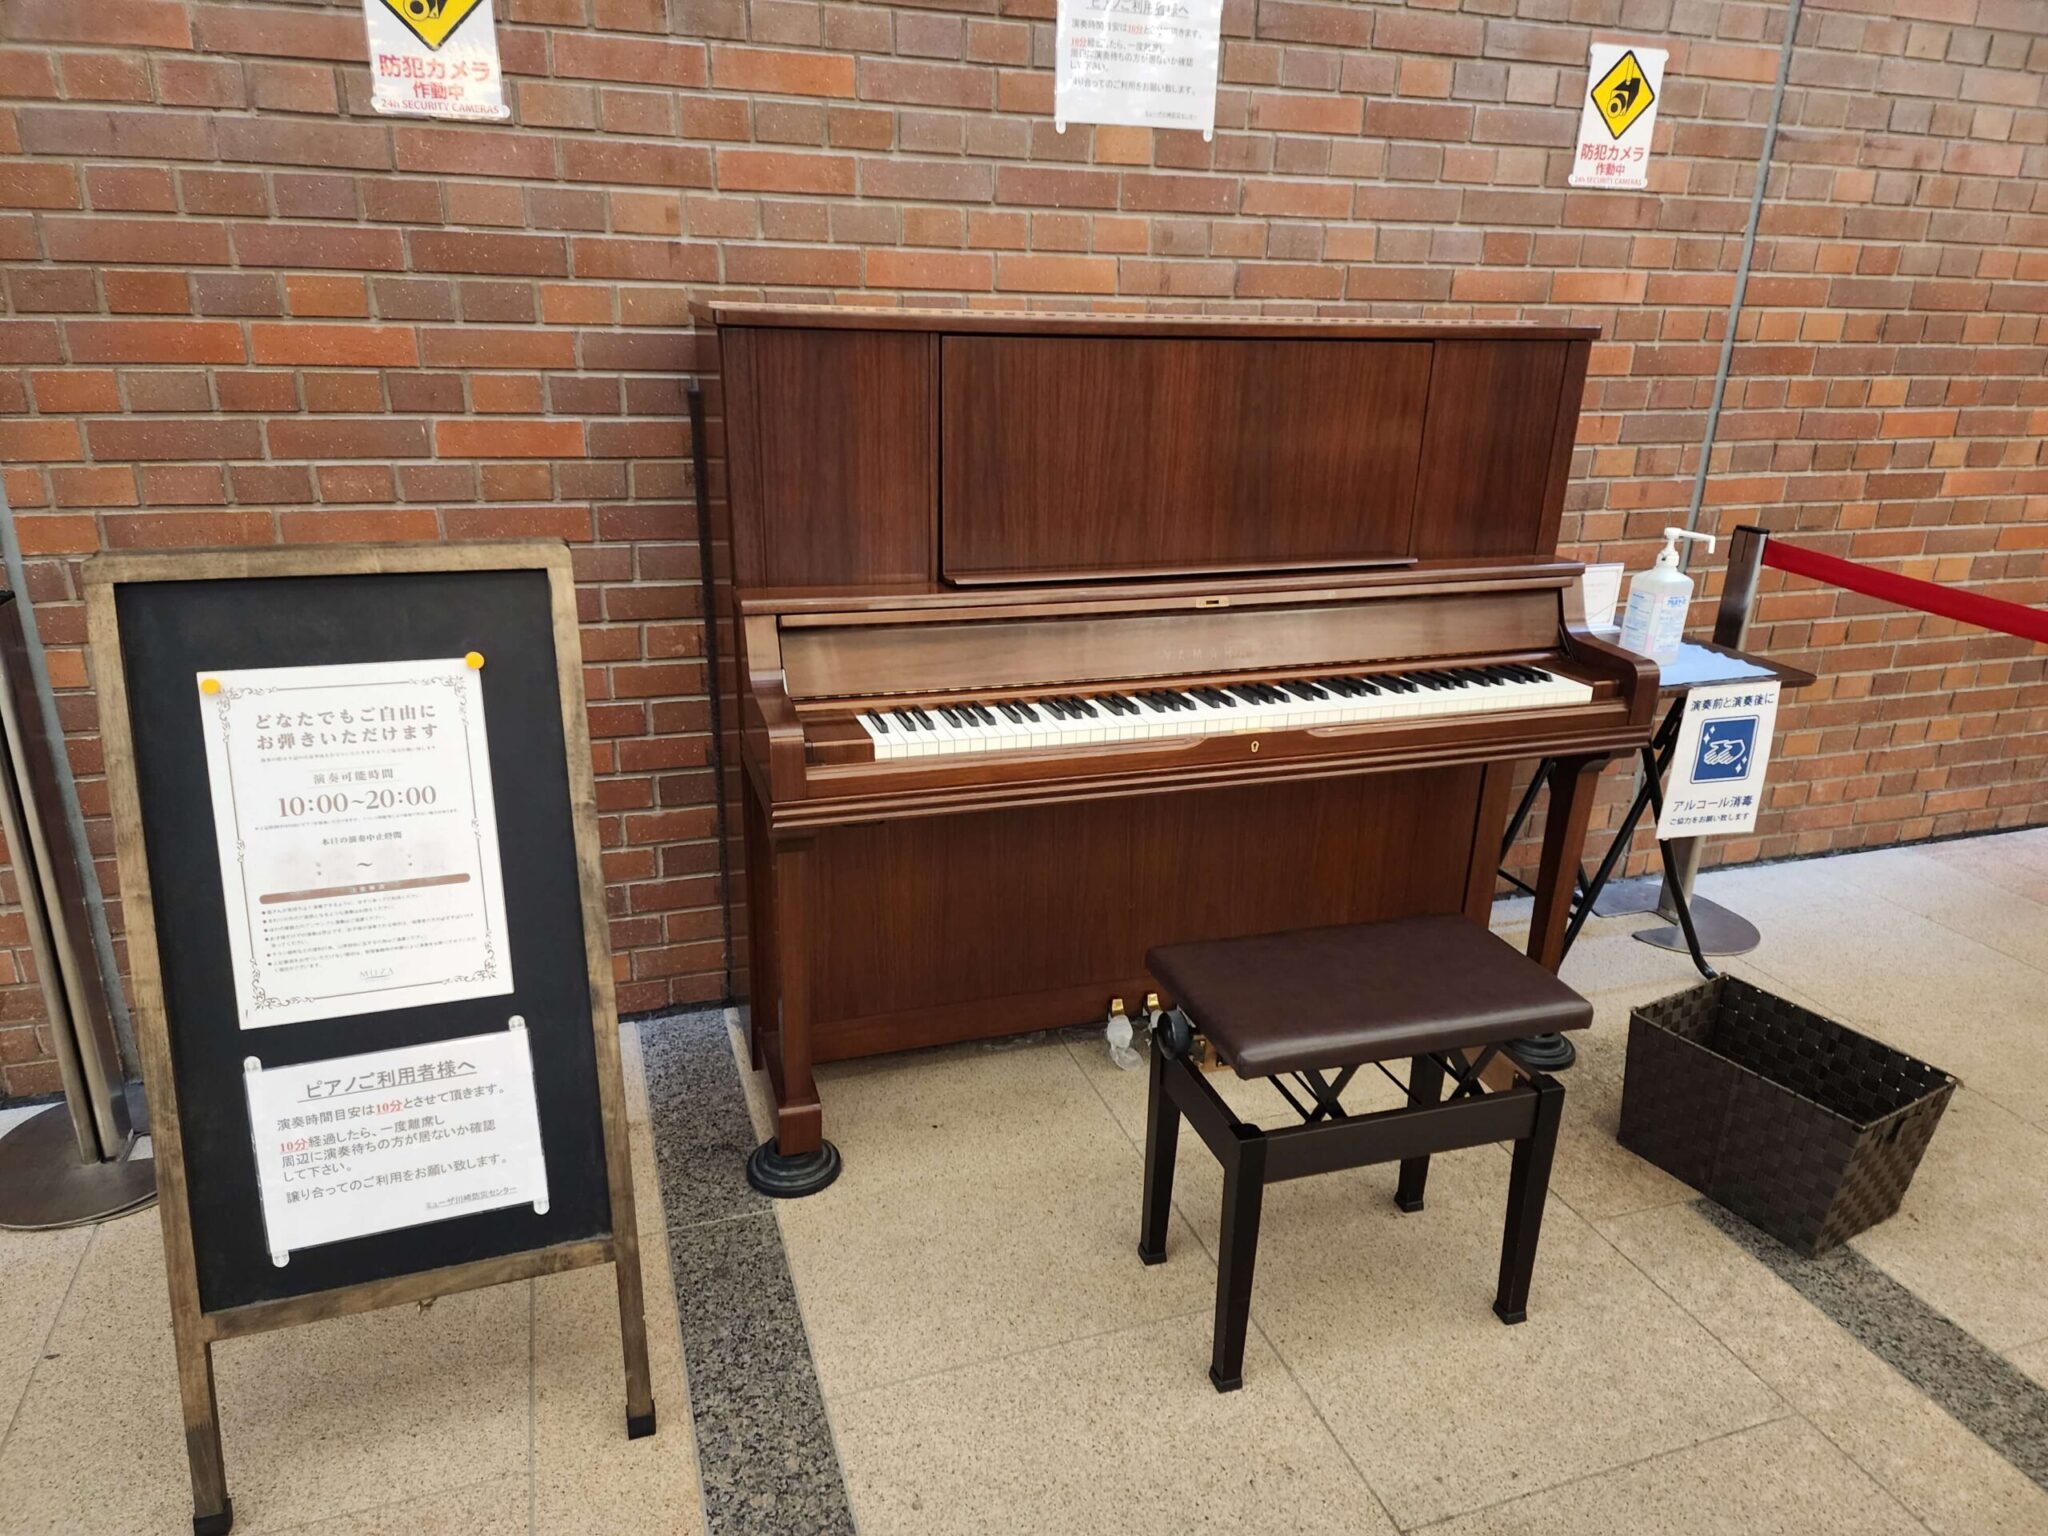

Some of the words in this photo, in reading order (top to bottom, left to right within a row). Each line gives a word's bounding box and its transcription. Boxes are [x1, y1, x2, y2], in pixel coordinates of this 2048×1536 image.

[379, 54, 490, 82] 防犯カメラ
[412, 81, 464, 100] 作動中
[402, 100, 449, 111] SECURITY
[451, 103, 499, 114] CAMERAS
[1580, 143, 1645, 162] 防犯カメラ
[1595, 163, 1626, 177] 作動中
[1162, 647, 1240, 661] YAMAH
[1690, 691, 1775, 713] 演奏前と演奏後に
[255, 704, 436, 730] どなたでもご自由に
[256, 723, 438, 751] お弾きいただけます
[313, 768, 394, 785] 演奏可能時間
[1673, 794, 1754, 812] アルコール消毒
[1669, 812, 1751, 826] ご協力をお願い致します
[322, 831, 402, 846] 本日の演奏中止時間
[306, 1060, 476, 1099] ピアノご利用者様へ
[276, 1083, 505, 1132] 演奏時間目安は10分とさせて頂きます。
[279, 1115, 446, 1154] 10分経過したら、一度離席し
[281, 1119, 497, 1169] 周辺に演奏待ちの方が居ないか確認
[283, 1161, 352, 1183] して下さい。
[286, 1153, 508, 1205] 譲り合ってのご利用をお願い致します。
